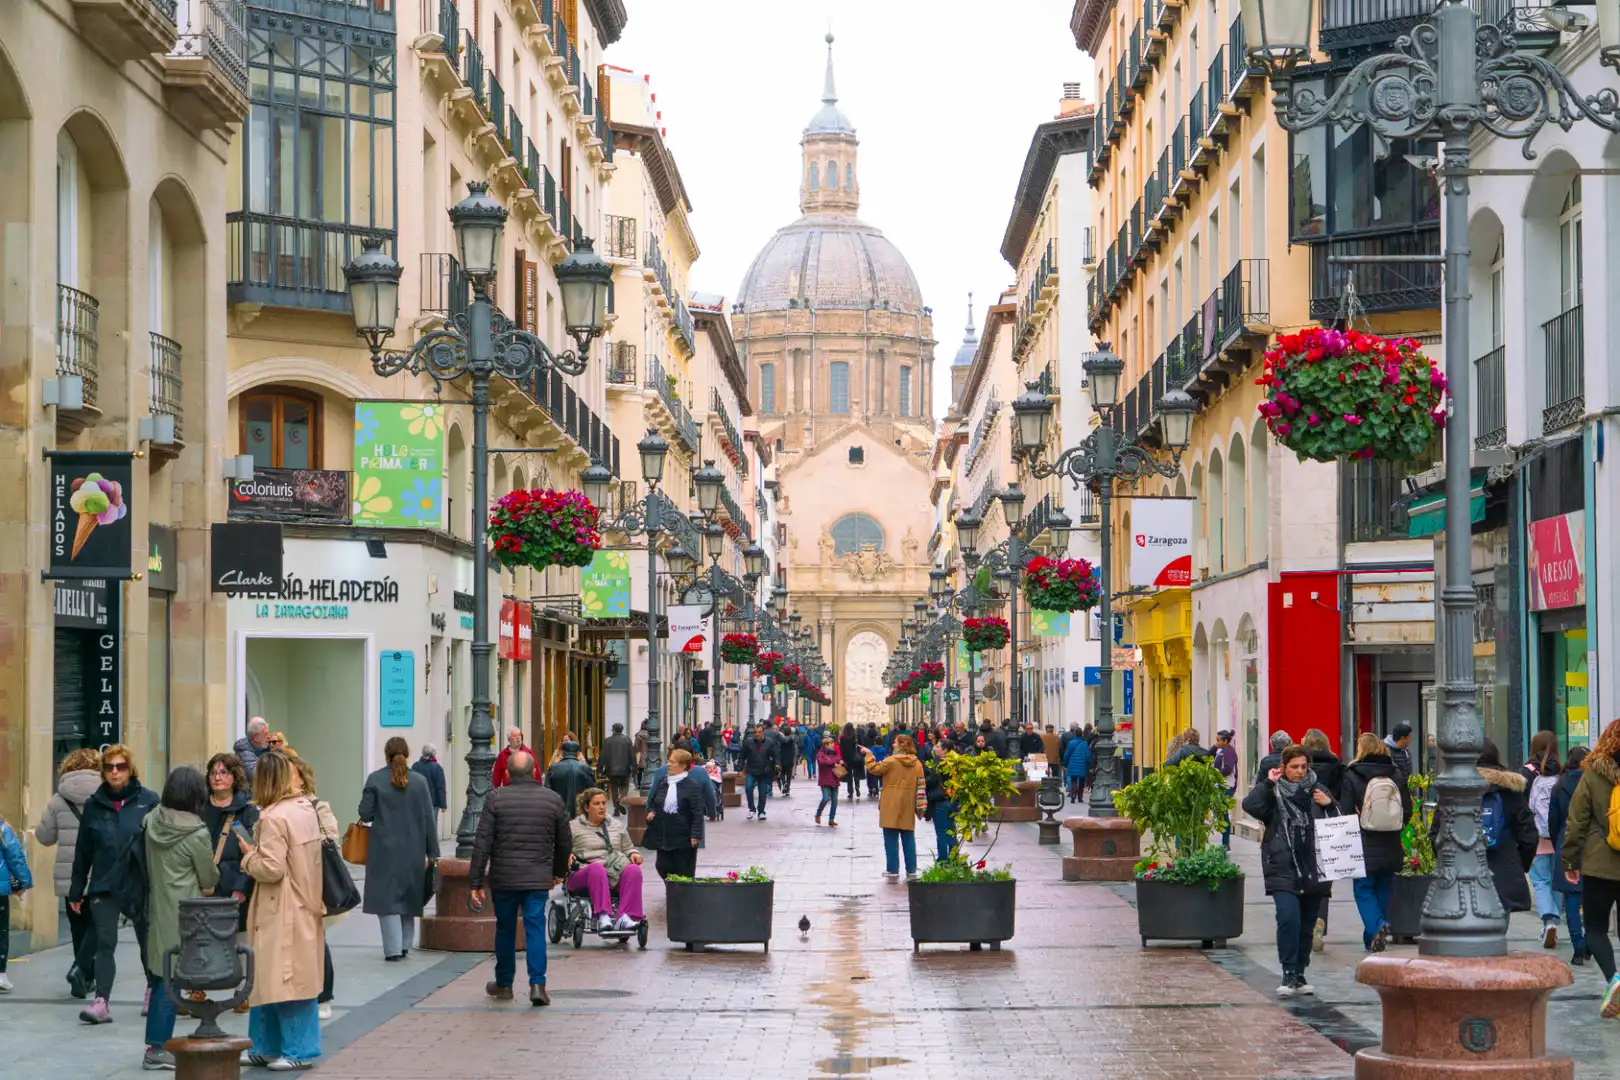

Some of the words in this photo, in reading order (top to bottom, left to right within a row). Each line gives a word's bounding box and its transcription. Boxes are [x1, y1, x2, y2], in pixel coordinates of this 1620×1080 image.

[239, 481, 293, 497] coloriuris
[55, 474, 66, 556] HELADOS
[1148, 535, 1188, 547] Zaragoza
[218, 569, 273, 586] Clarks
[1542, 558, 1573, 584] ARESSO
[255, 603, 269, 618] LA
[274, 604, 349, 620] ZARAGOZANA
